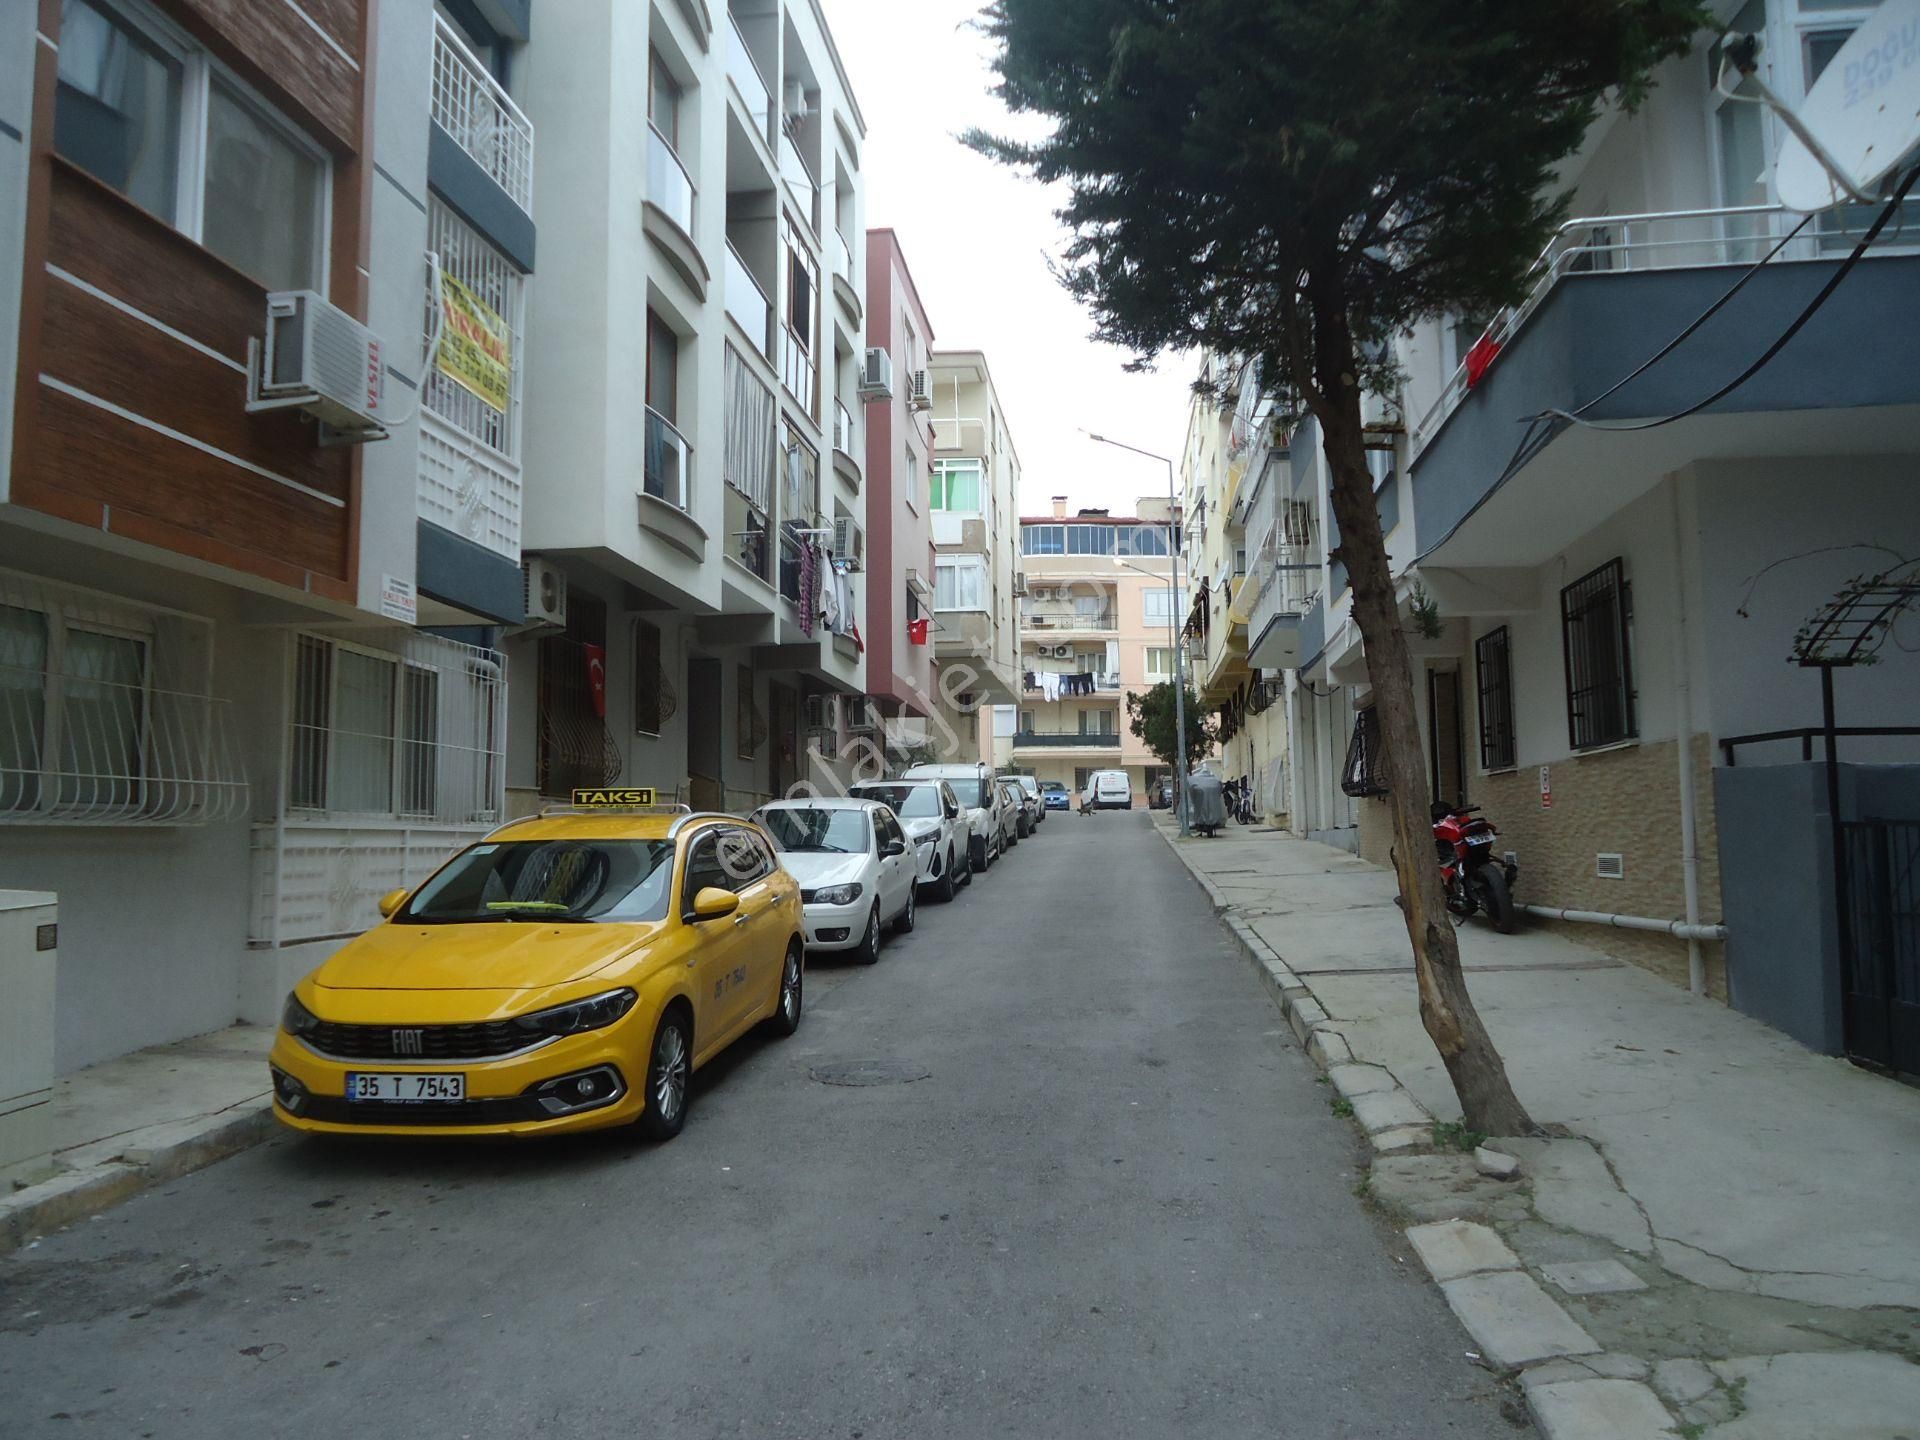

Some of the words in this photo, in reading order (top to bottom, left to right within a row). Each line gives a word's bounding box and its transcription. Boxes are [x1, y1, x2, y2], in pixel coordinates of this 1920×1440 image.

[391, 1029, 424, 1054] FIAT
[358, 1077, 379, 1097] 35
[393, 1077, 402, 1097] T
[416, 1077, 460, 1097] 7543
